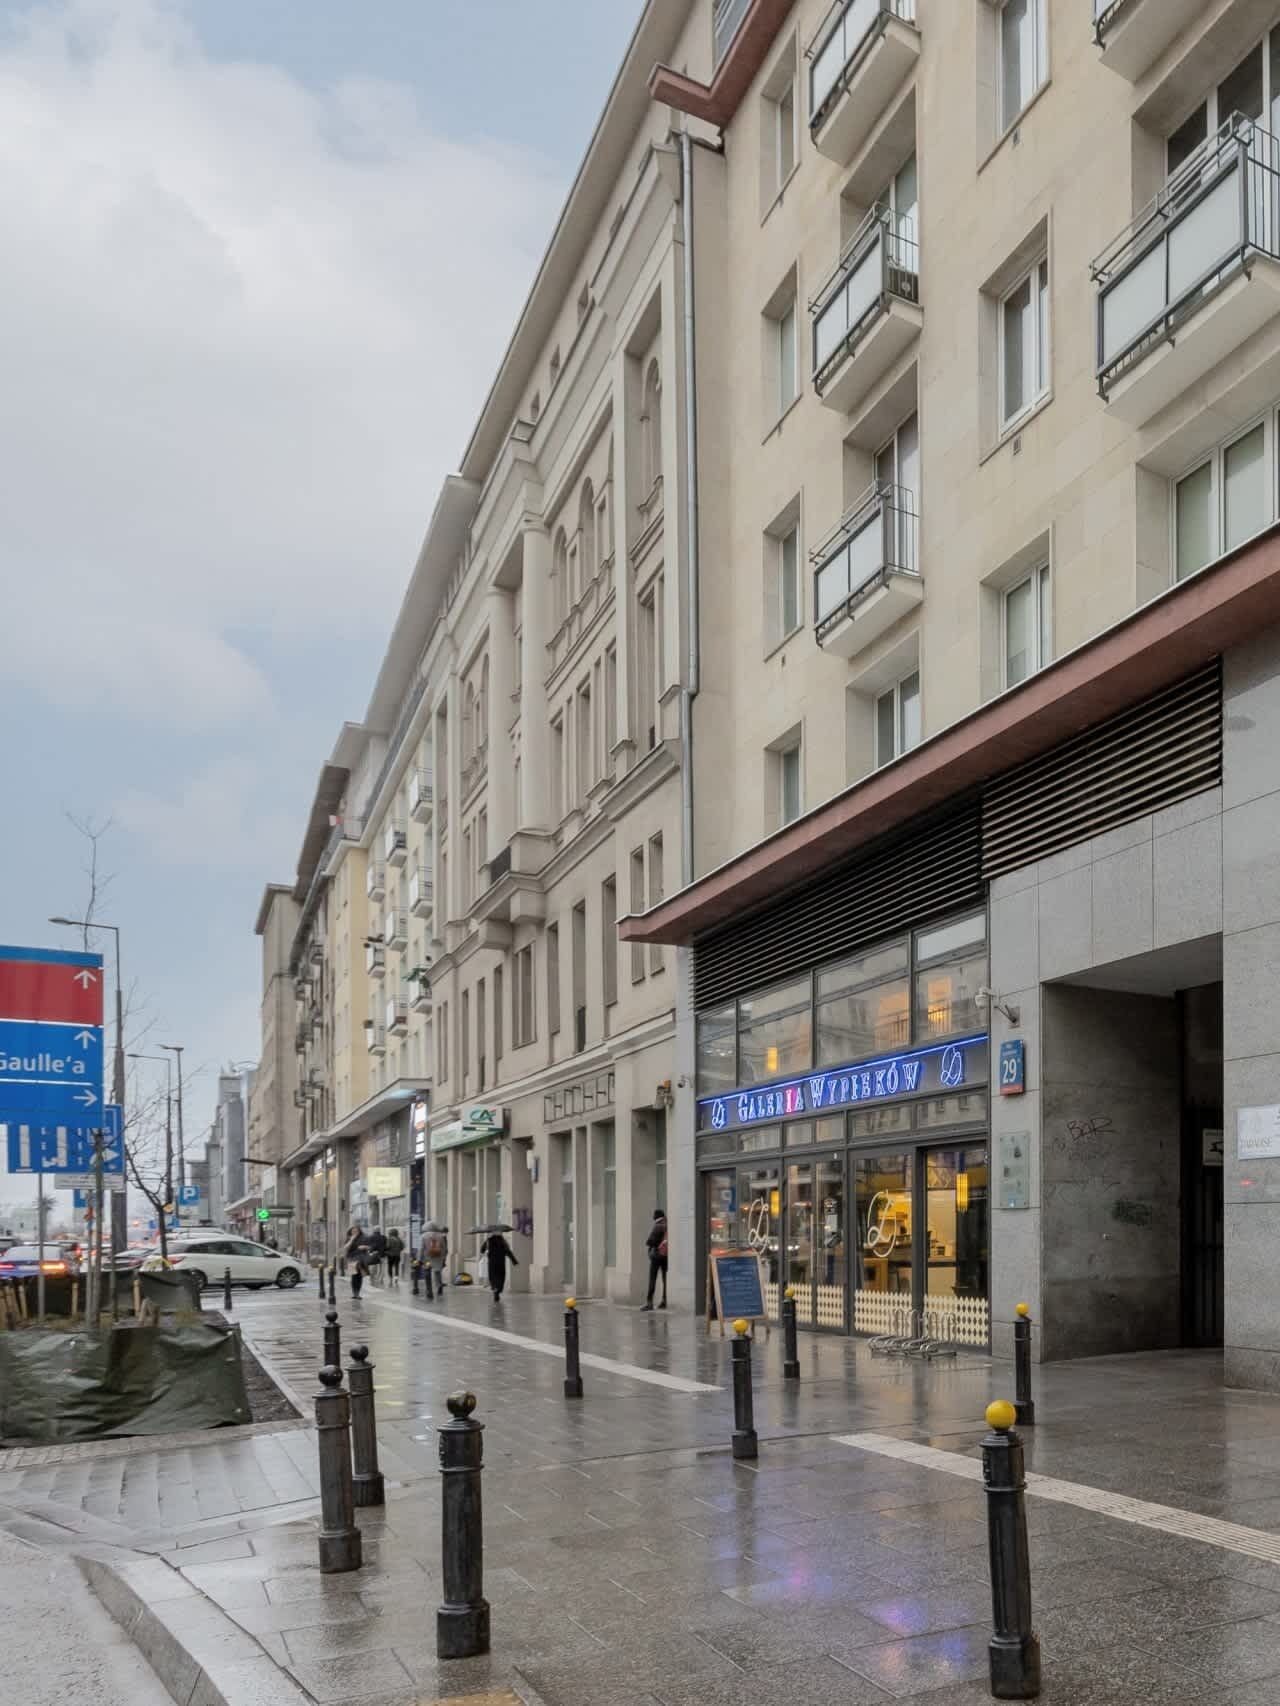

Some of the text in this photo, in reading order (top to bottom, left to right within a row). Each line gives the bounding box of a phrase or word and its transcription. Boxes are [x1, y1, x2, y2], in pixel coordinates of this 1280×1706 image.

[1002, 1059, 1017, 1084] 29
[738, 1062, 919, 1122] GALERIA WYPIEKÓW
[183, 1187, 196, 1200] P
